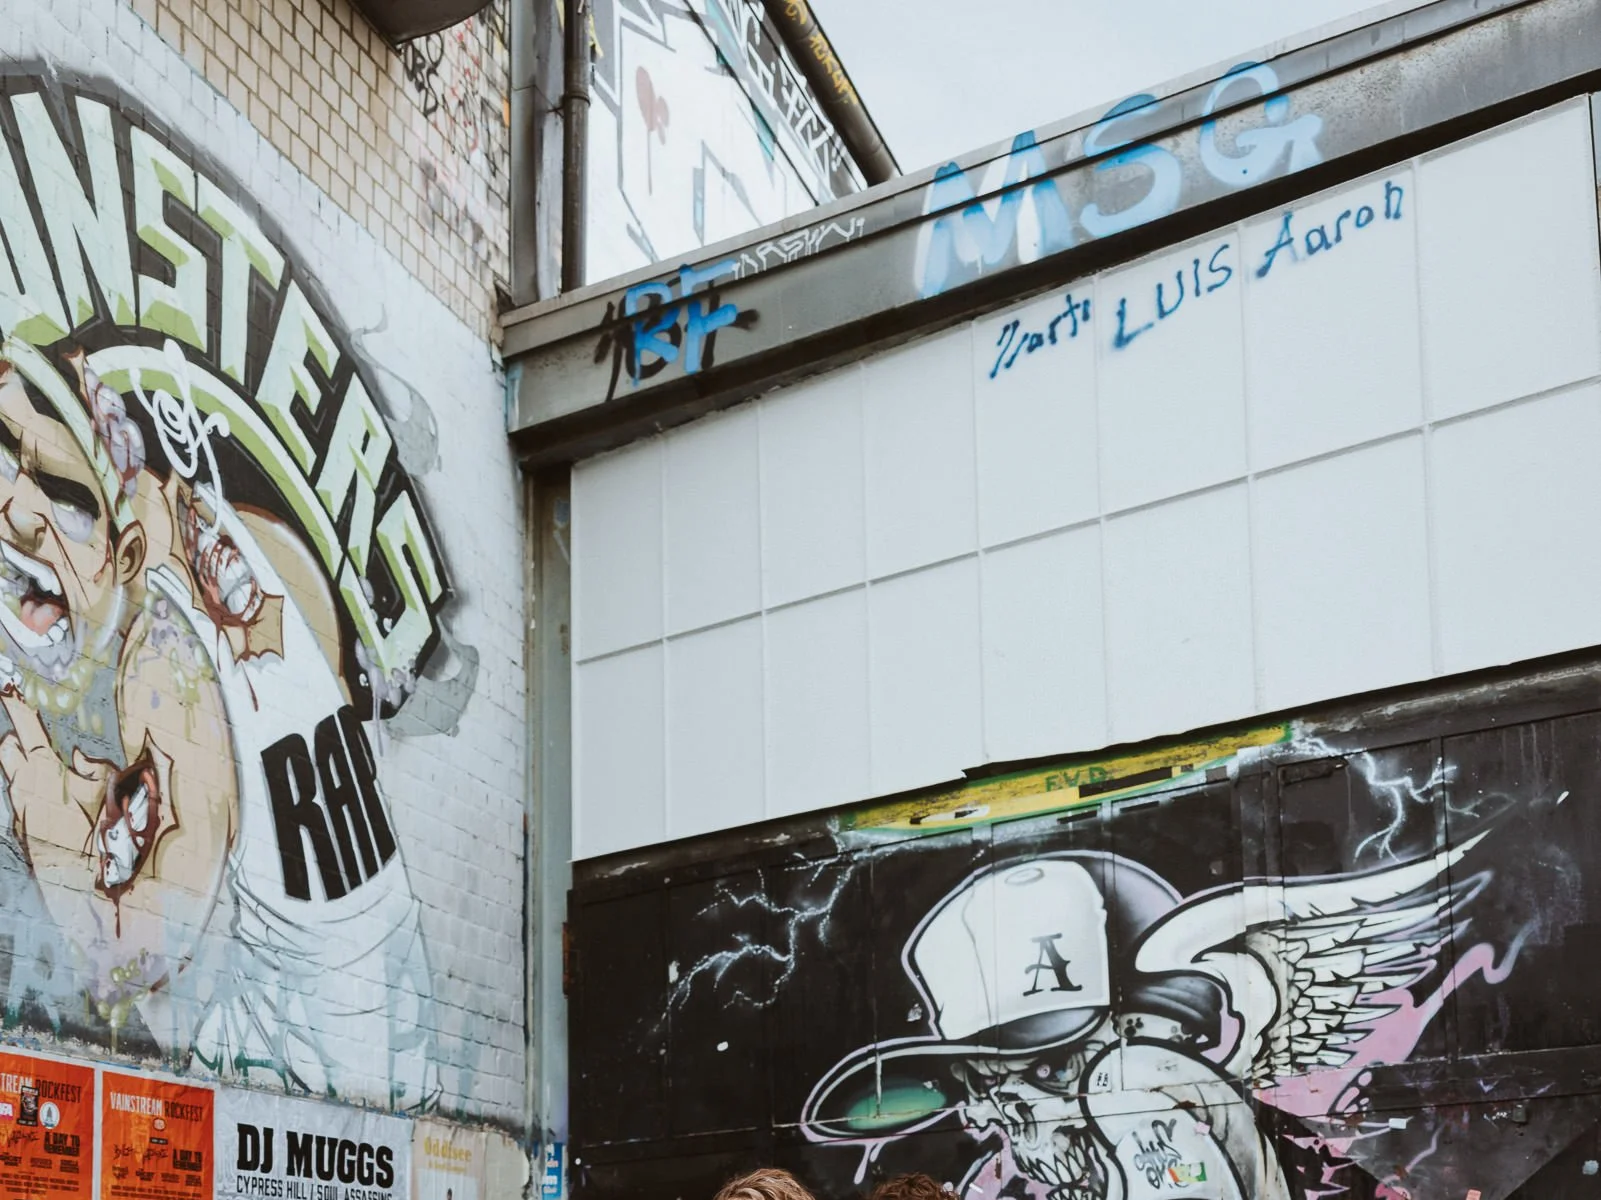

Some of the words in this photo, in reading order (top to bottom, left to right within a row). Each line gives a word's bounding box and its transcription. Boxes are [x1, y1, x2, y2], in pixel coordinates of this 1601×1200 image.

[912, 60, 1324, 299] MSG
[1110, 243, 1233, 351] LUIS
[1255, 180, 1404, 279] Aaron
[259, 704, 398, 901] RAP
[1022, 932, 1083, 997] A
[110, 1092, 163, 1117] VAINSTREAM
[165, 1100, 204, 1122] ROCKFEST
[236, 1175, 283, 1198] CYPRESS
[286, 1180, 307, 1200] HILL
[237, 1123, 274, 1174] DJ
[286, 1130, 394, 1189] MUGGS
